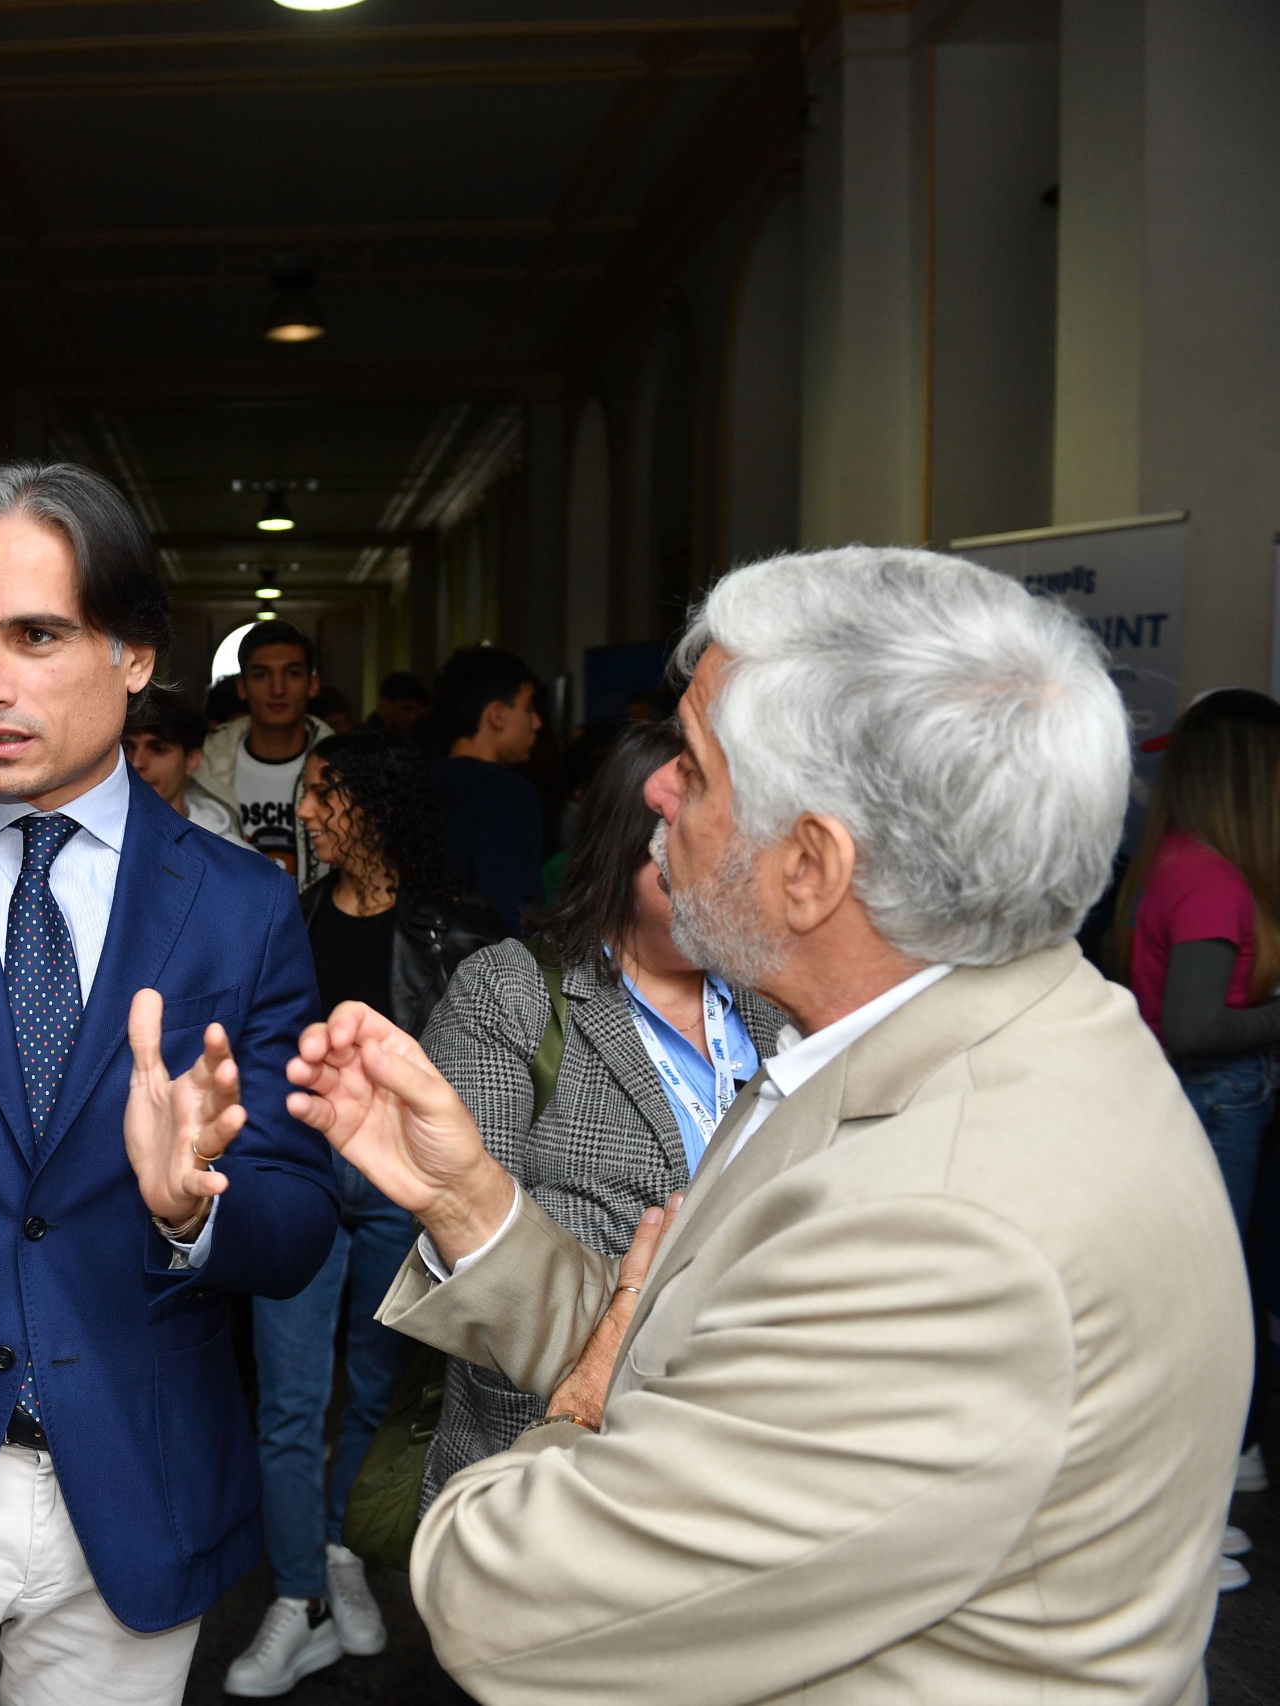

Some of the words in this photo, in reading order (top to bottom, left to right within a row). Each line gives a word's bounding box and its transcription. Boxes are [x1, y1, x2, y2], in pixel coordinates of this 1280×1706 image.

[1084, 612, 1168, 648] INT
[711, 1038, 725, 1060] CAMPUS
[659, 1060, 681, 1086] CAMPUS
